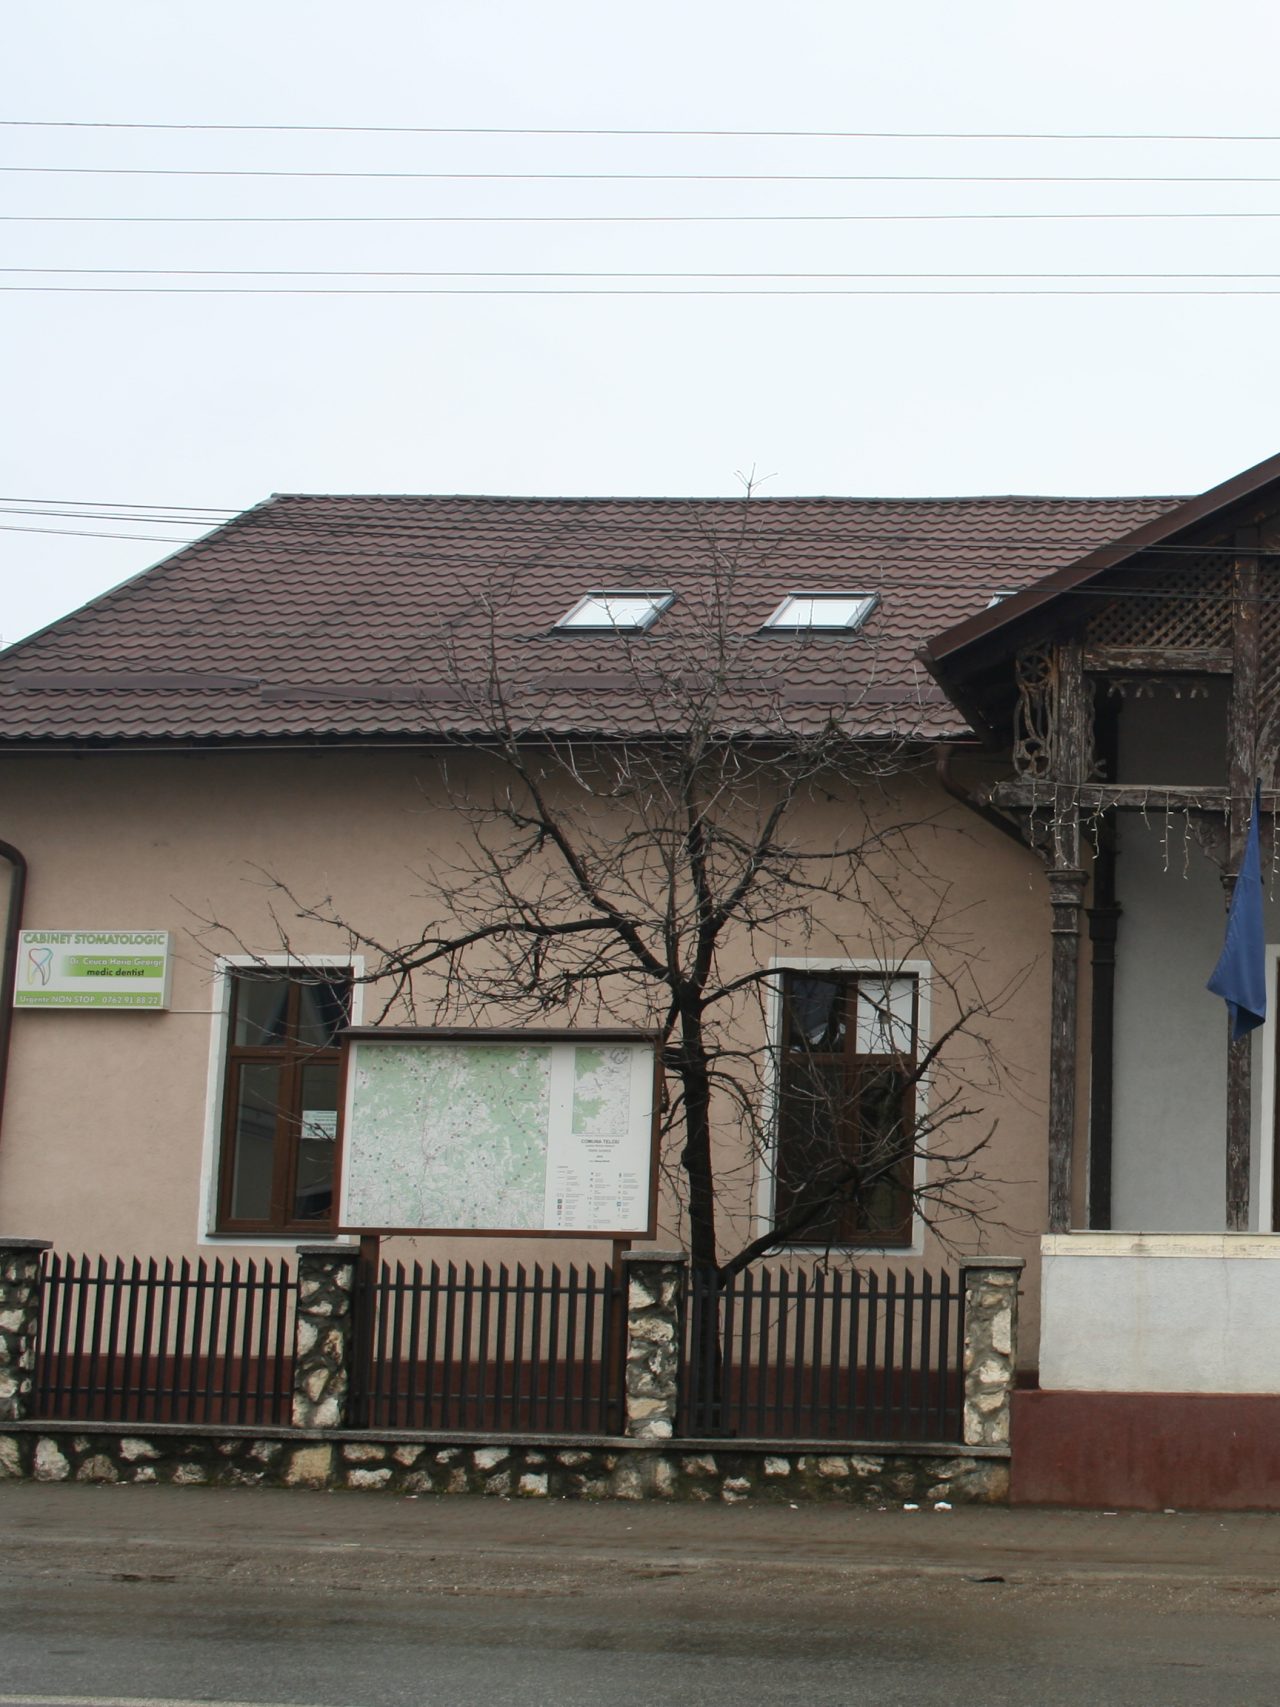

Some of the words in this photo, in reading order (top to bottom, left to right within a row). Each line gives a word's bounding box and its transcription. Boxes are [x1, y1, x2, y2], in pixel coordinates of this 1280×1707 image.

[23, 933, 72, 945] CABINET
[74, 934, 165, 946] STOMATOLOGIC
[86, 967, 113, 976] medic
[115, 967, 145, 977] dentist
[51, 995, 72, 1003] NON
[73, 995, 95, 1003] STOP
